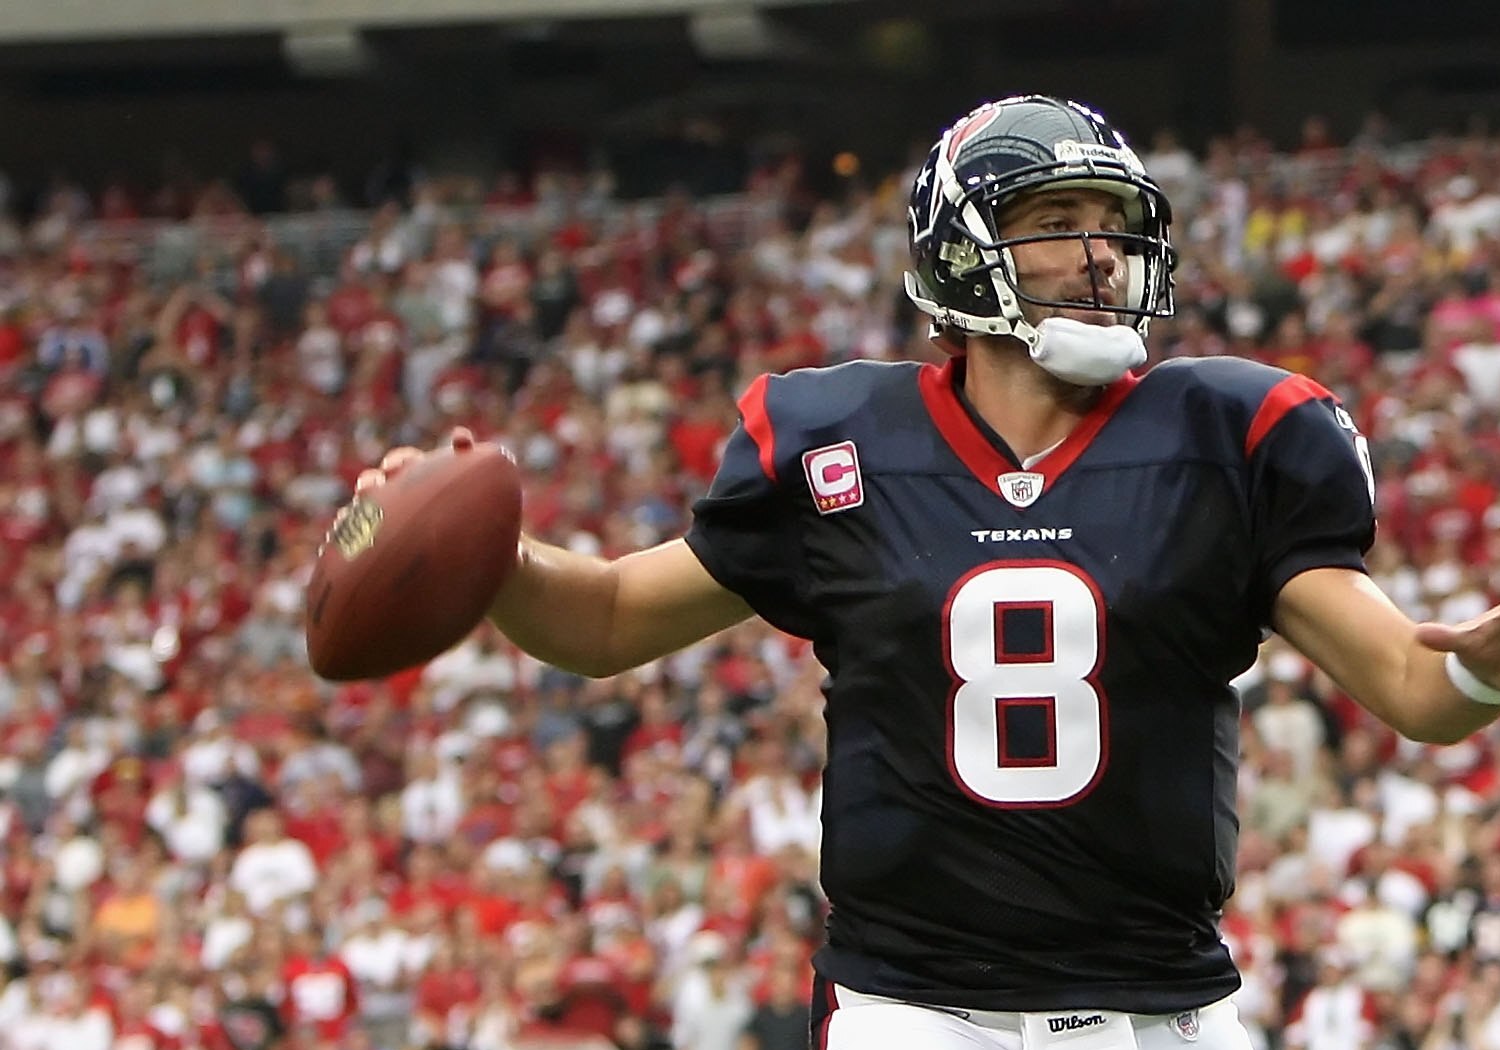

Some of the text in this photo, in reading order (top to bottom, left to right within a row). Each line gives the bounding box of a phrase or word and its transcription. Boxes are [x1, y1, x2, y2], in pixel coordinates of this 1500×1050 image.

[810, 449, 856, 496] C
[970, 528, 1073, 543] TEXANS
[941, 559, 1109, 809] 8
[1048, 1015, 1106, 1033] Wilson
